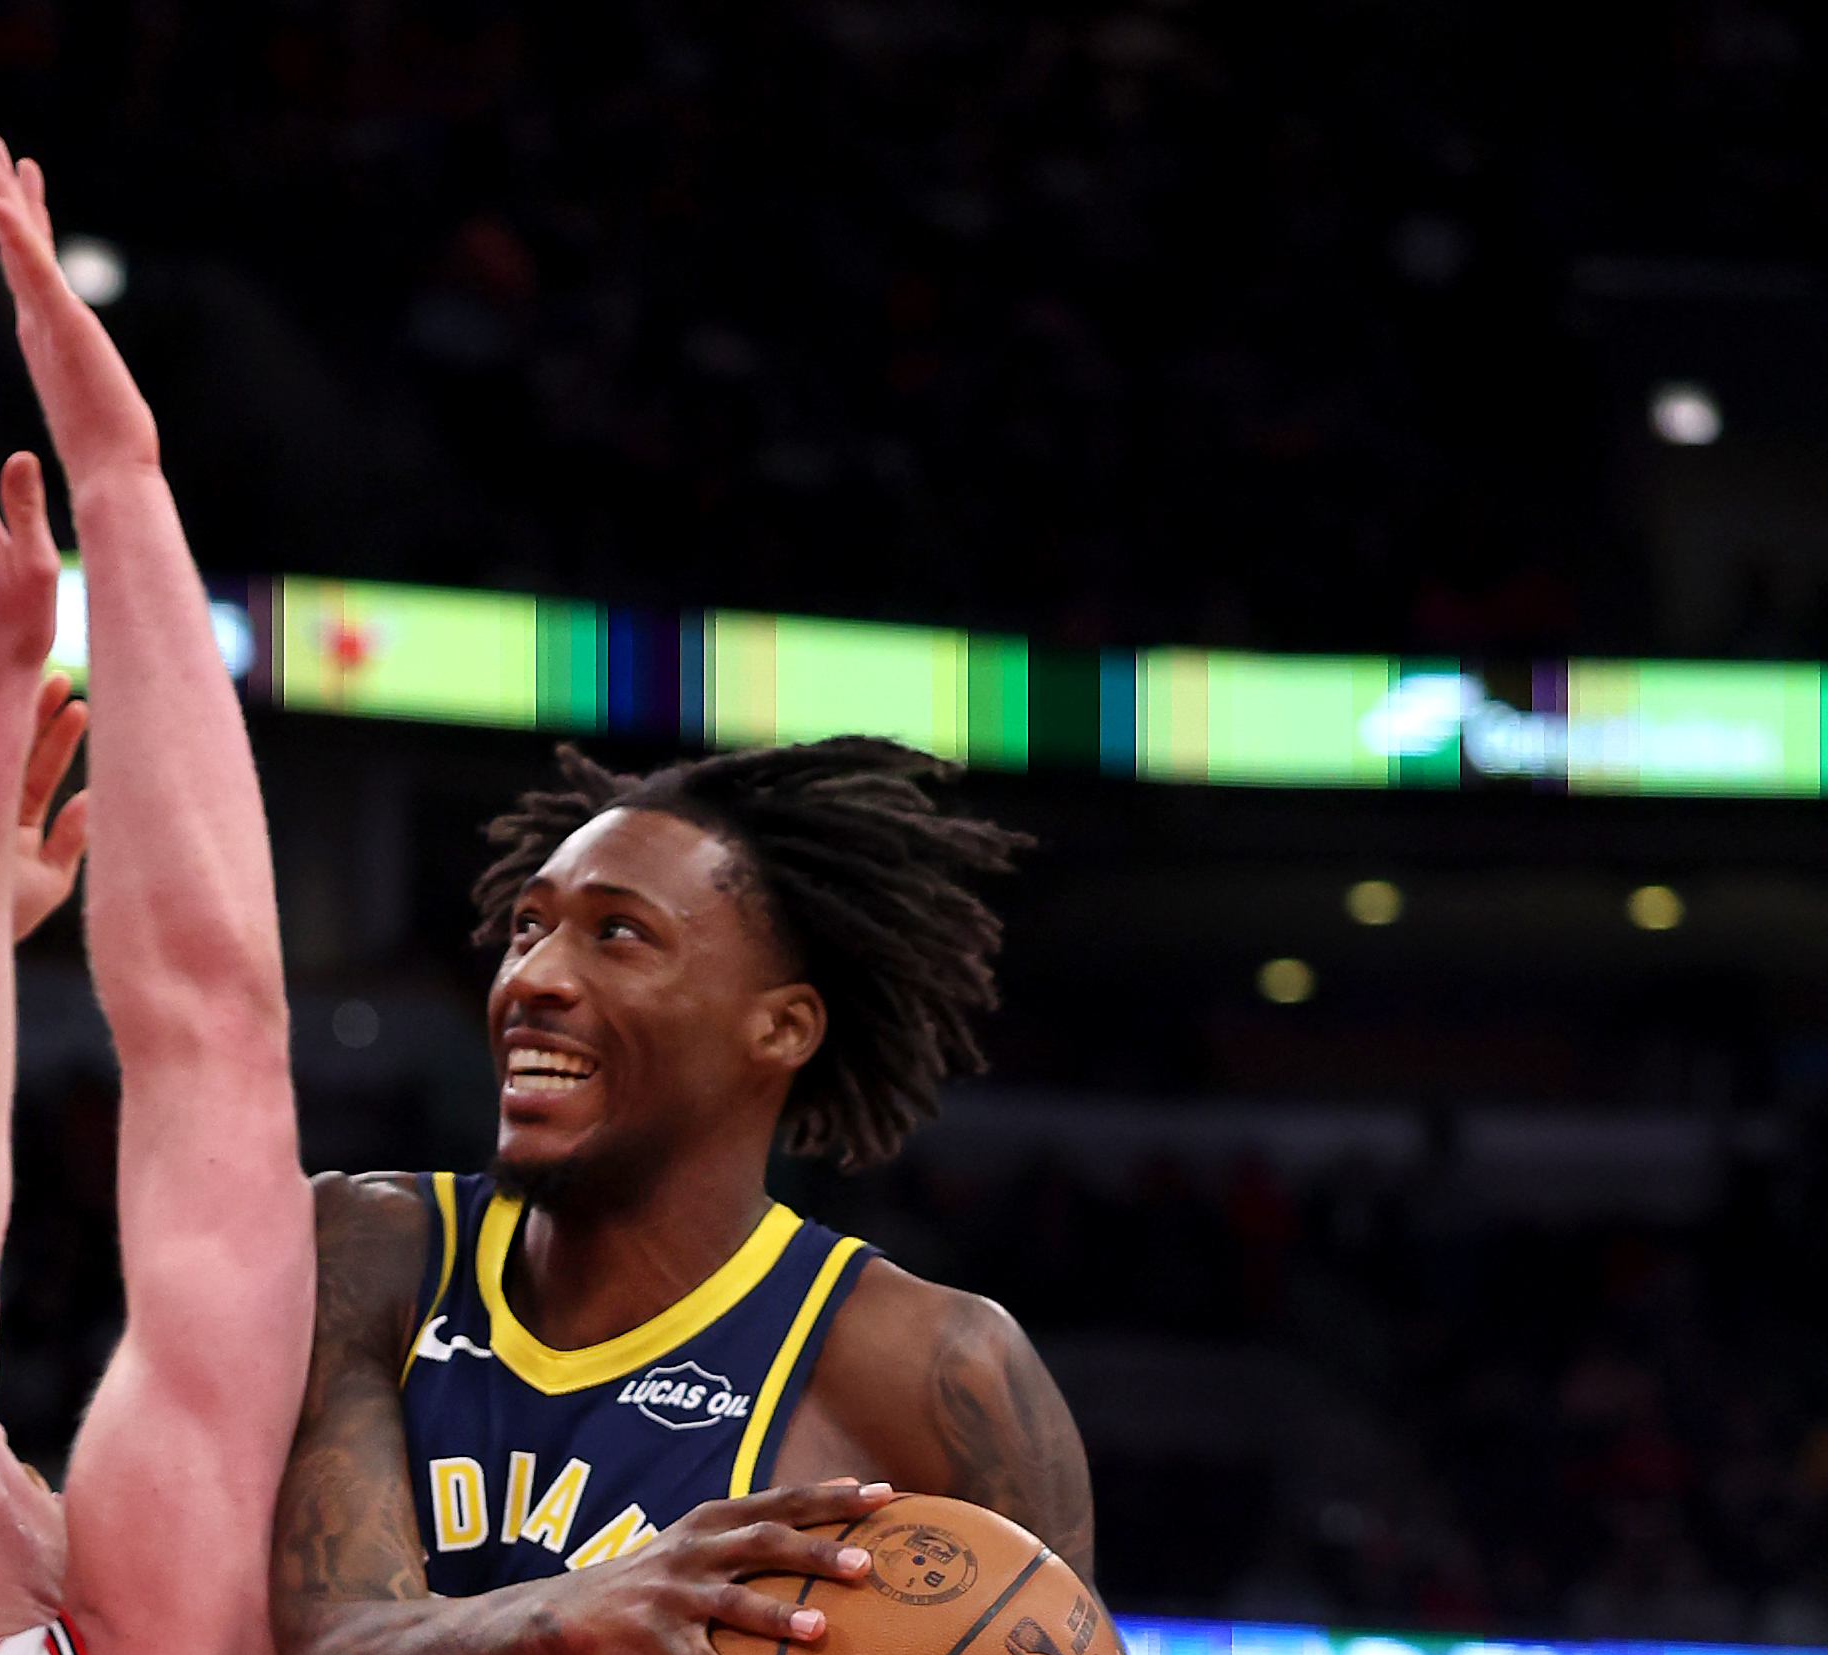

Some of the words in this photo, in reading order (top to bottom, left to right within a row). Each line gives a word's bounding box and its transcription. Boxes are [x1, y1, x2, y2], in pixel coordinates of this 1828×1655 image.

[617, 1380, 707, 1410] LUCAS
[706, 1390, 750, 1418] OIL
[429, 1450, 659, 1571] DIAN
